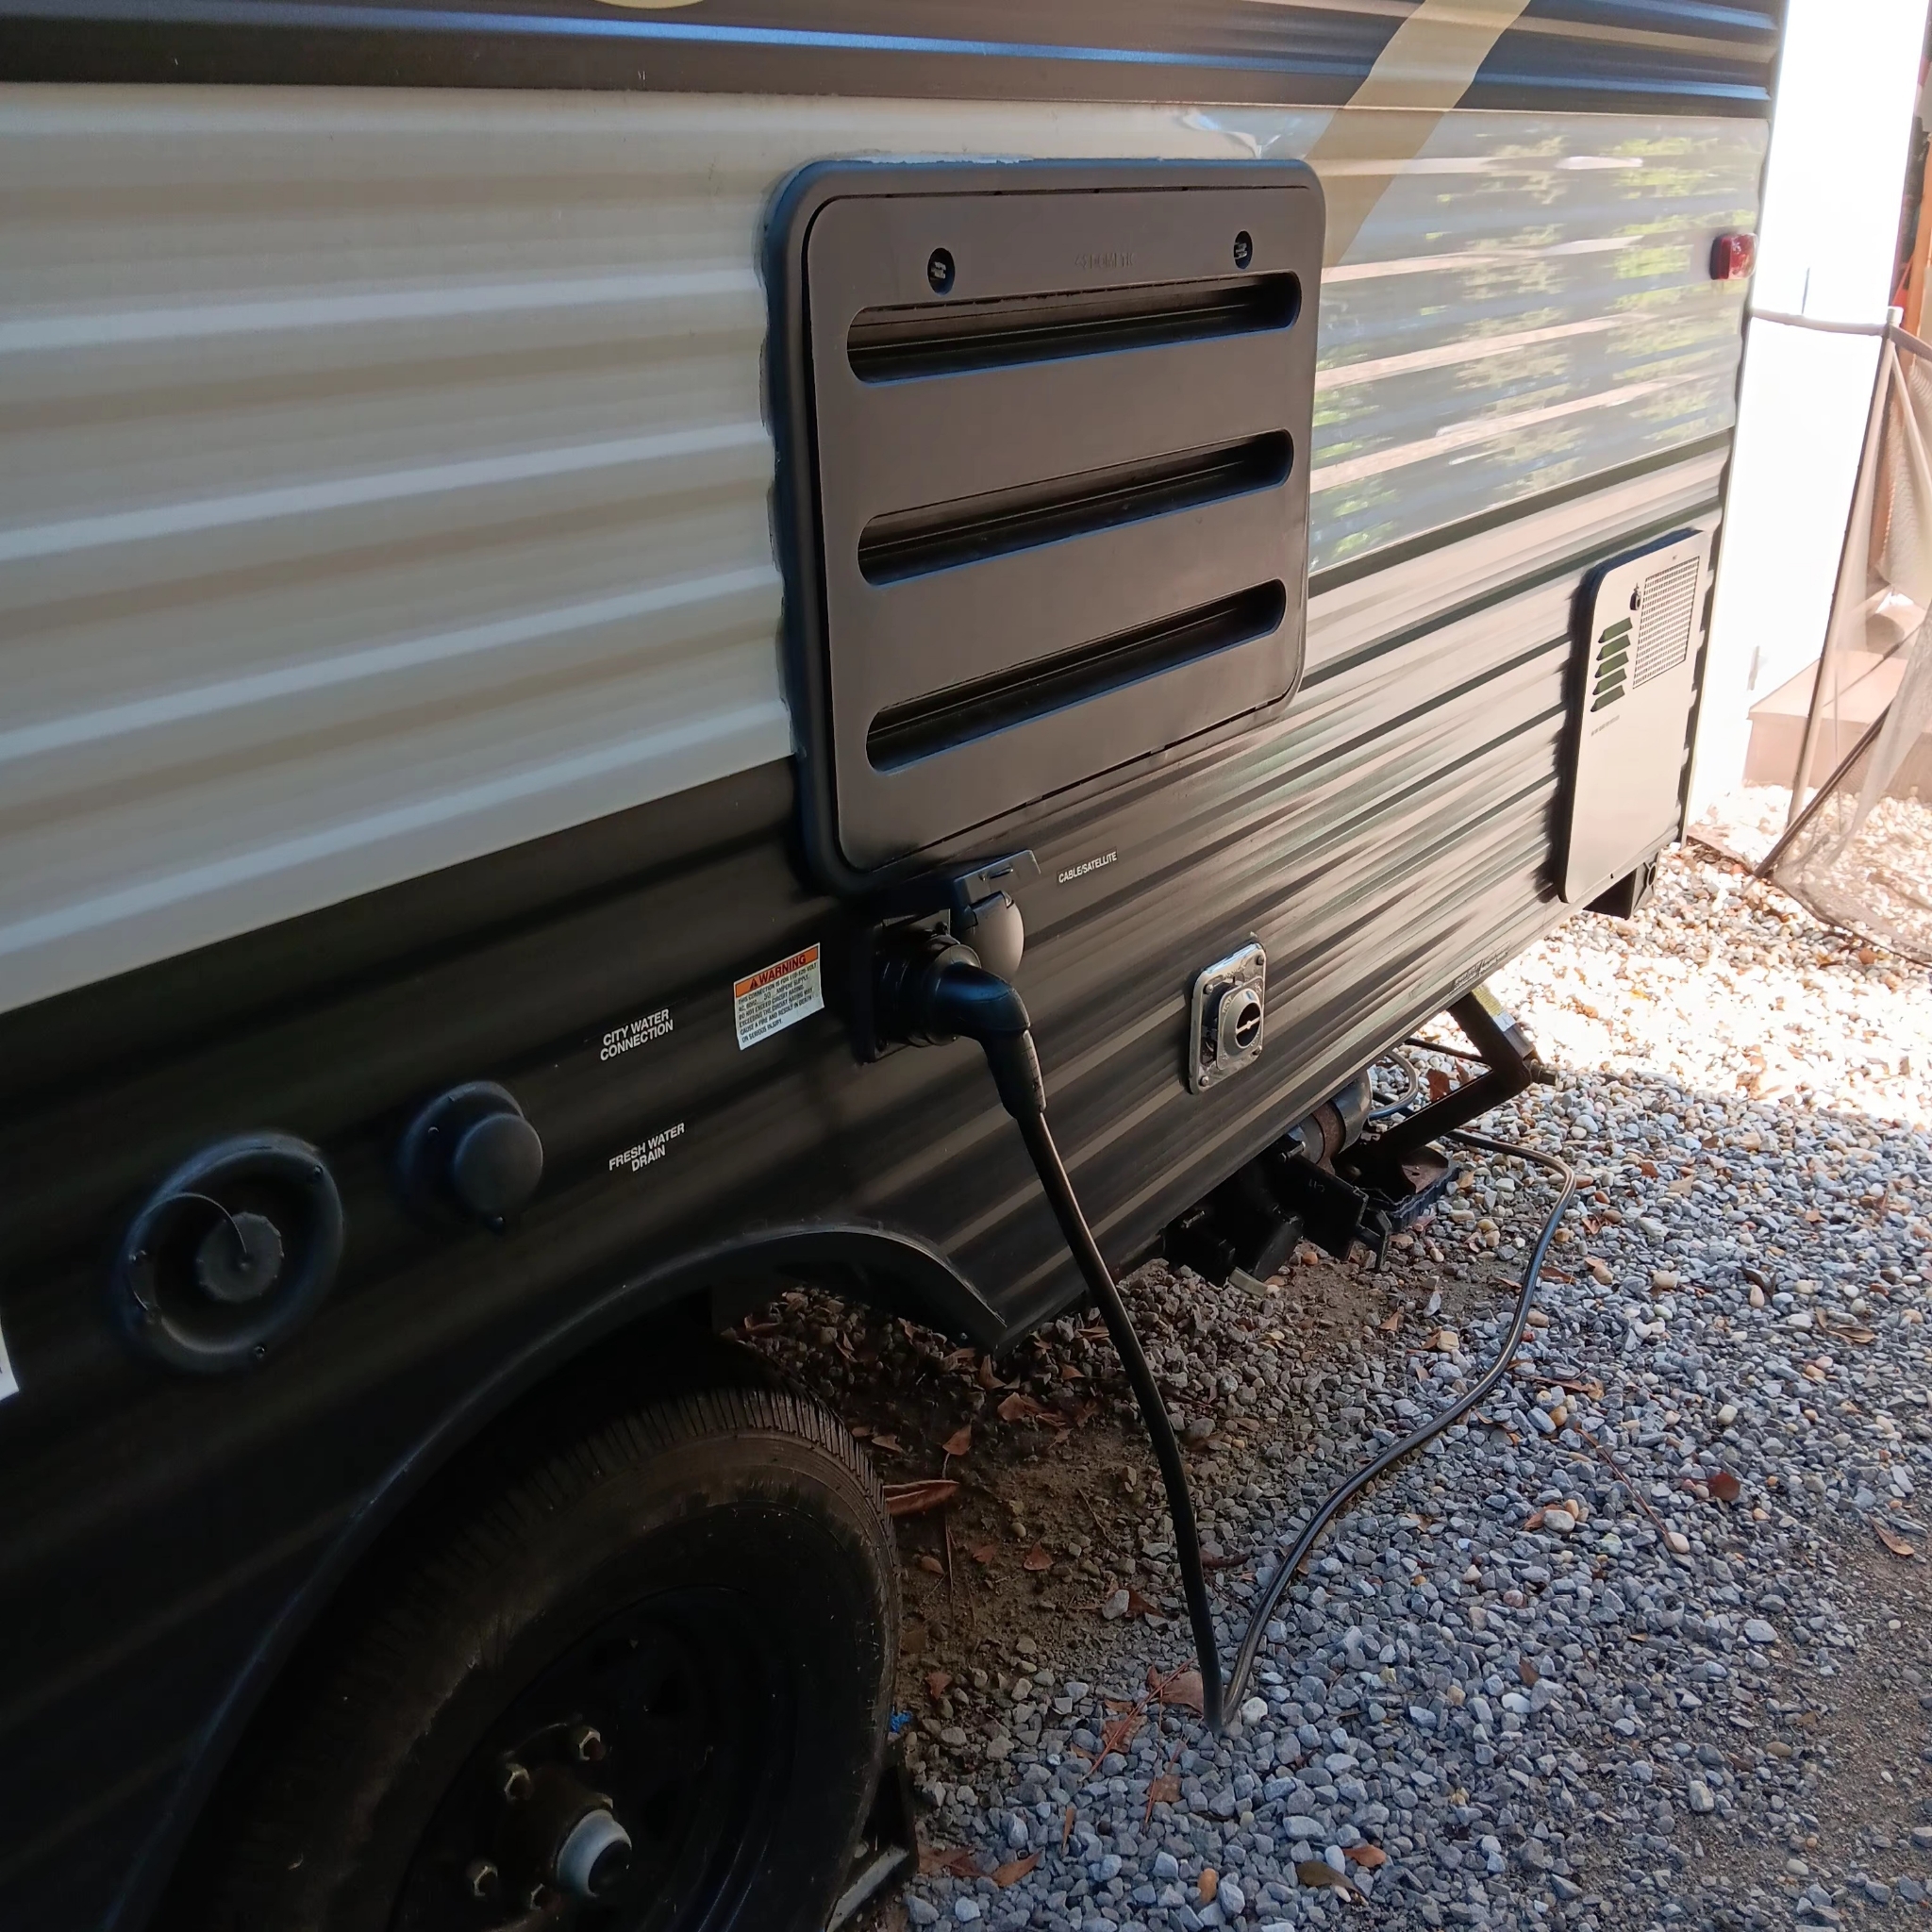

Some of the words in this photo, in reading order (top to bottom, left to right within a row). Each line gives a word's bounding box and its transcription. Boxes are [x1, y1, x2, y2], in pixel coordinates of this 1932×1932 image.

[1058, 851, 1117, 883] CABLE/SATELLITE
[758, 953, 807, 986] WARNING
[748, 982, 774, 1000] CONNECTION
[745, 1008, 755, 1017] NOT
[755, 999, 771, 1012] EXCEED
[763, 1007, 772, 1016] THE
[603, 1024, 629, 1046] CITY
[630, 1008, 669, 1035] WATER
[740, 1024, 754, 1036] CAUSE
[758, 1016, 768, 1026] FIRE
[769, 1011, 777, 1021] AND
[600, 1019, 674, 1061] CONNECTION
[608, 1141, 646, 1171] FRESH
[647, 1122, 685, 1150] WATER
[631, 1144, 666, 1172] DRAIN
